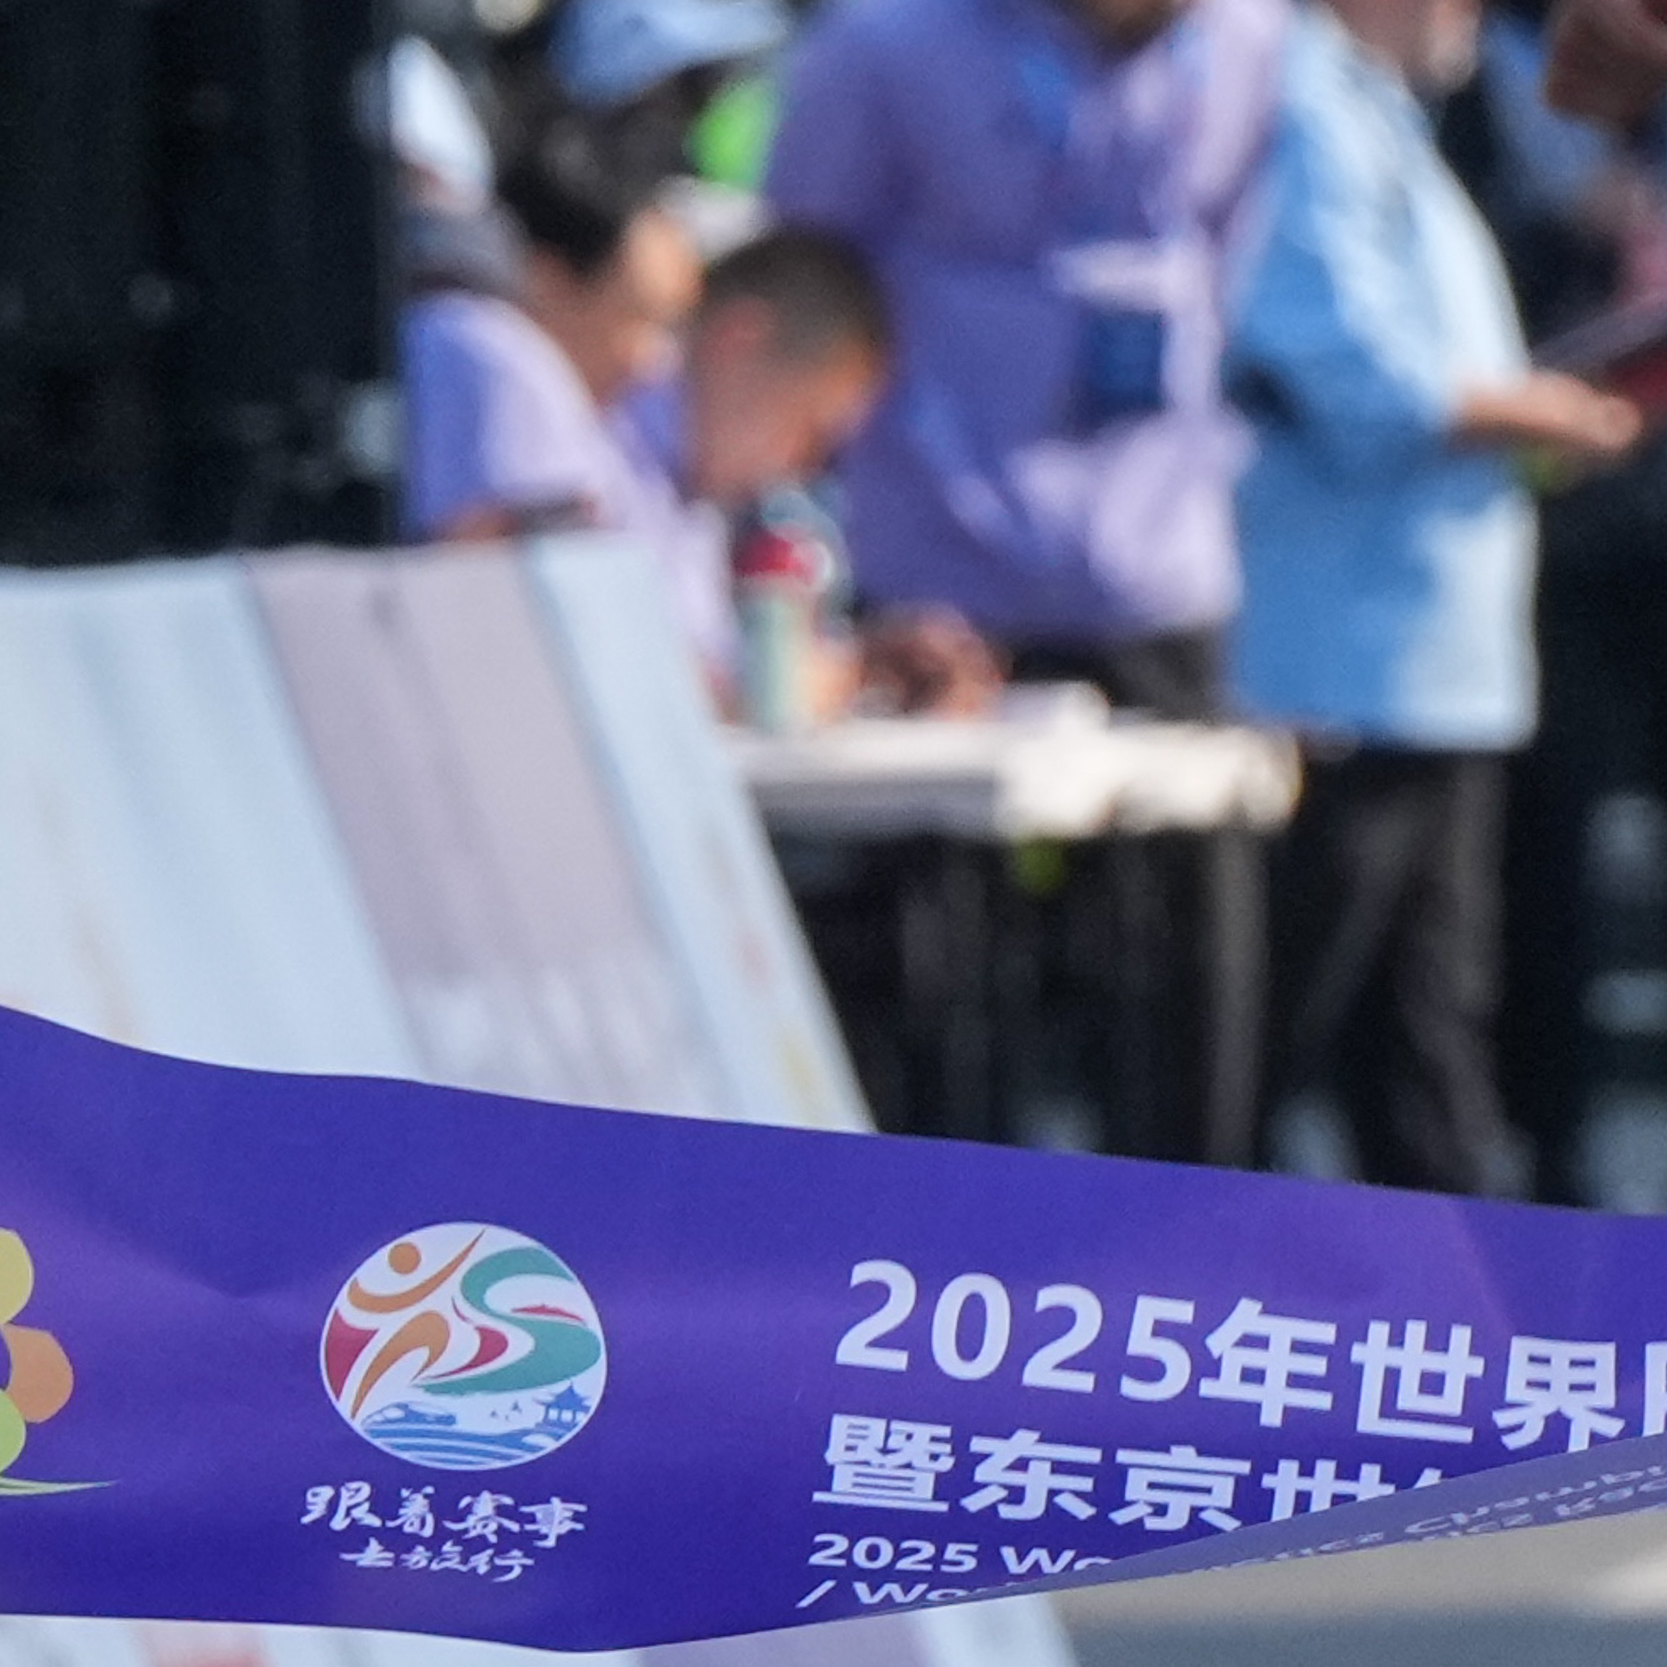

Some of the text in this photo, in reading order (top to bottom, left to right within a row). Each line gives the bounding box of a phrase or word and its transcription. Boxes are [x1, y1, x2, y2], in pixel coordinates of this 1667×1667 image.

[300, 1481, 588, 1548] 跟着赛事
[339, 1536, 535, 1582] 去旅行
[808, 1534, 978, 1573] 2025
